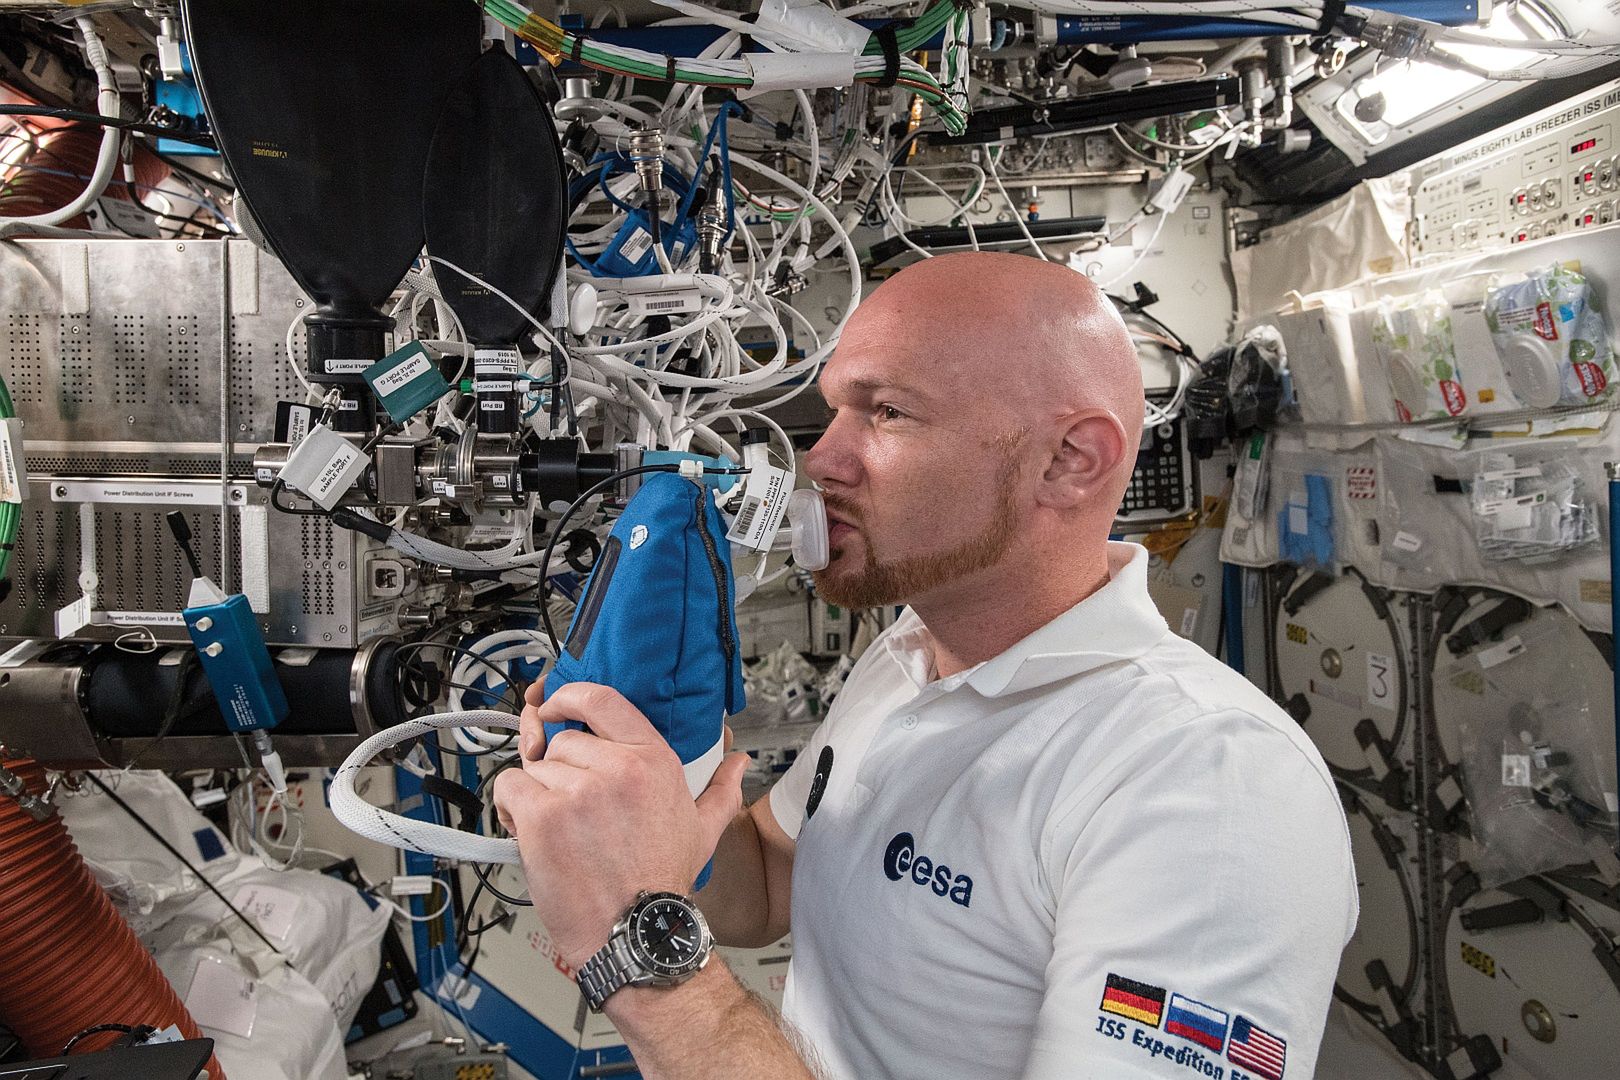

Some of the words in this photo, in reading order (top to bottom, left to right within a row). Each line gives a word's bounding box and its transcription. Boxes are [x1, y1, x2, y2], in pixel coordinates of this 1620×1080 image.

[1454, 149, 1478, 166] MINUS
[1481, 136, 1511, 155] EIGHTY
[1515, 128, 1533, 143] LAB
[1536, 109, 1581, 134] FREEZER
[1584, 100, 1601, 115] ISS
[385, 370, 400, 384] PORT
[399, 358, 421, 374] SAMPLE
[320, 473, 338, 493] SAMPLE
[336, 458, 348, 474] PORT
[768, 506, 782, 532] Restrictor
[1095, 1016, 1127, 1040] ISS
[1132, 1028, 1224, 1080] Expedition
